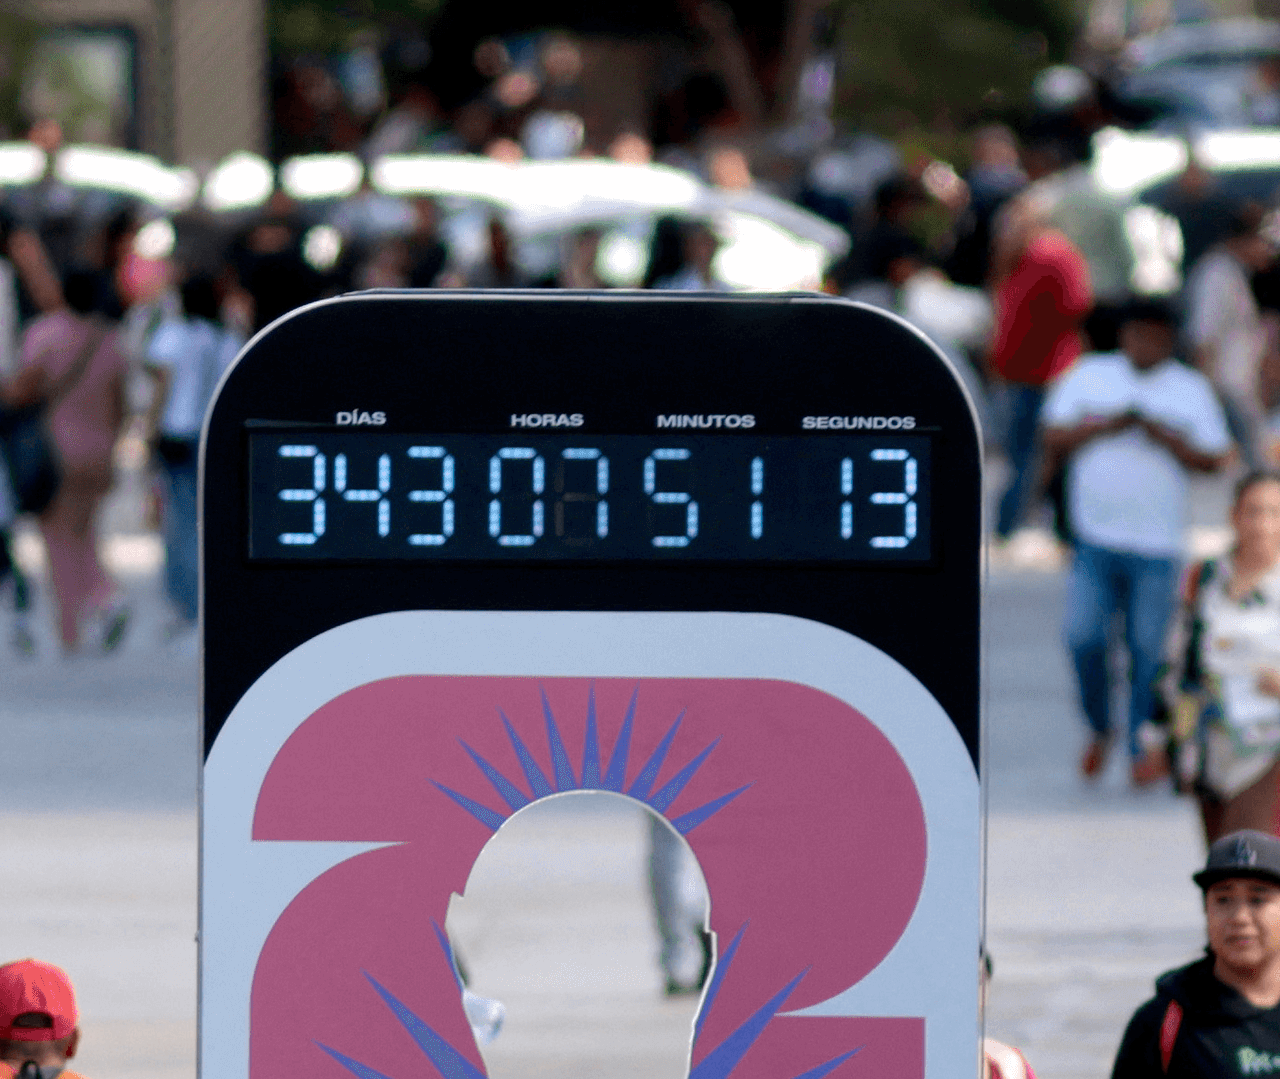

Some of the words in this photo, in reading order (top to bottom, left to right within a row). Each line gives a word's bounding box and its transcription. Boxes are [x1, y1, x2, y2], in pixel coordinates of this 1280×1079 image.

[336, 408, 387, 426] DÍAS
[510, 413, 585, 428] HORAS
[657, 413, 757, 429] MINUTOS
[802, 416, 917, 430] SEGUNDOS
[277, 443, 456, 546] 343
[488, 446, 610, 547] 07
[643, 447, 765, 548] 51
[840, 448, 919, 549] 13
